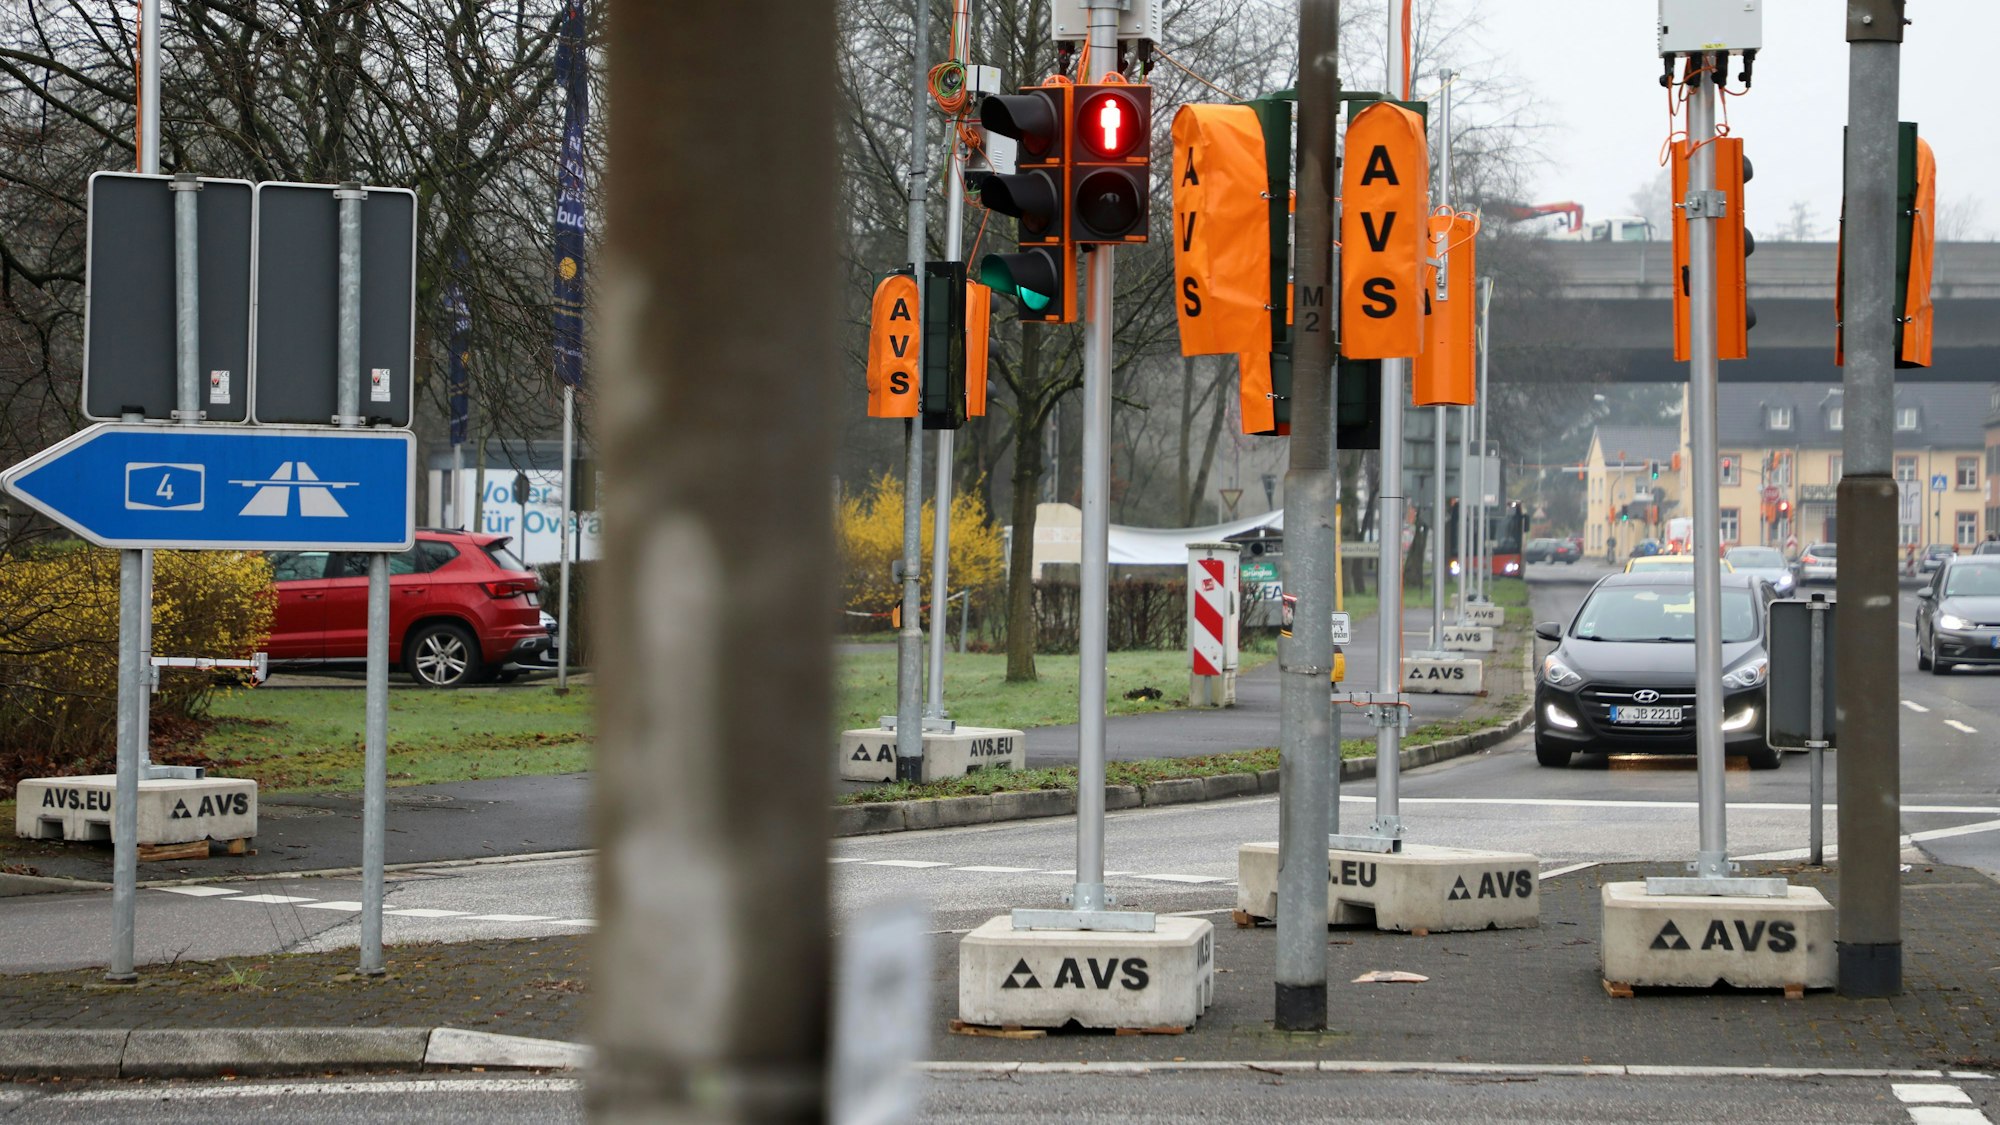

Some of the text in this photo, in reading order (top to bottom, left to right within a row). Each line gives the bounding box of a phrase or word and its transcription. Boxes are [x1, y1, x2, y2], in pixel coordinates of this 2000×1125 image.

[1181, 146, 1202, 317] AVS
[1360, 145, 1400, 319] AVS
[1303, 286, 1324, 307] M
[1304, 311, 1321, 333] 2
[889, 298, 911, 395] AVS
[156, 473, 174, 501] 4
[1474, 611, 1495, 619] AVS
[1455, 633, 1482, 642] AVS
[1428, 667, 1465, 680] AVS
[1617, 708, 1680, 720] K JB 2210
[970, 736, 1014, 757] AVS.EU
[42, 788, 112, 812] AVS.EU
[197, 792, 249, 819] AVS
[1328, 860, 1377, 888] .EU
[1477, 869, 1533, 900] AVS
[1700, 919, 1797, 954] AVS
[1053, 957, 1151, 991] AVS
